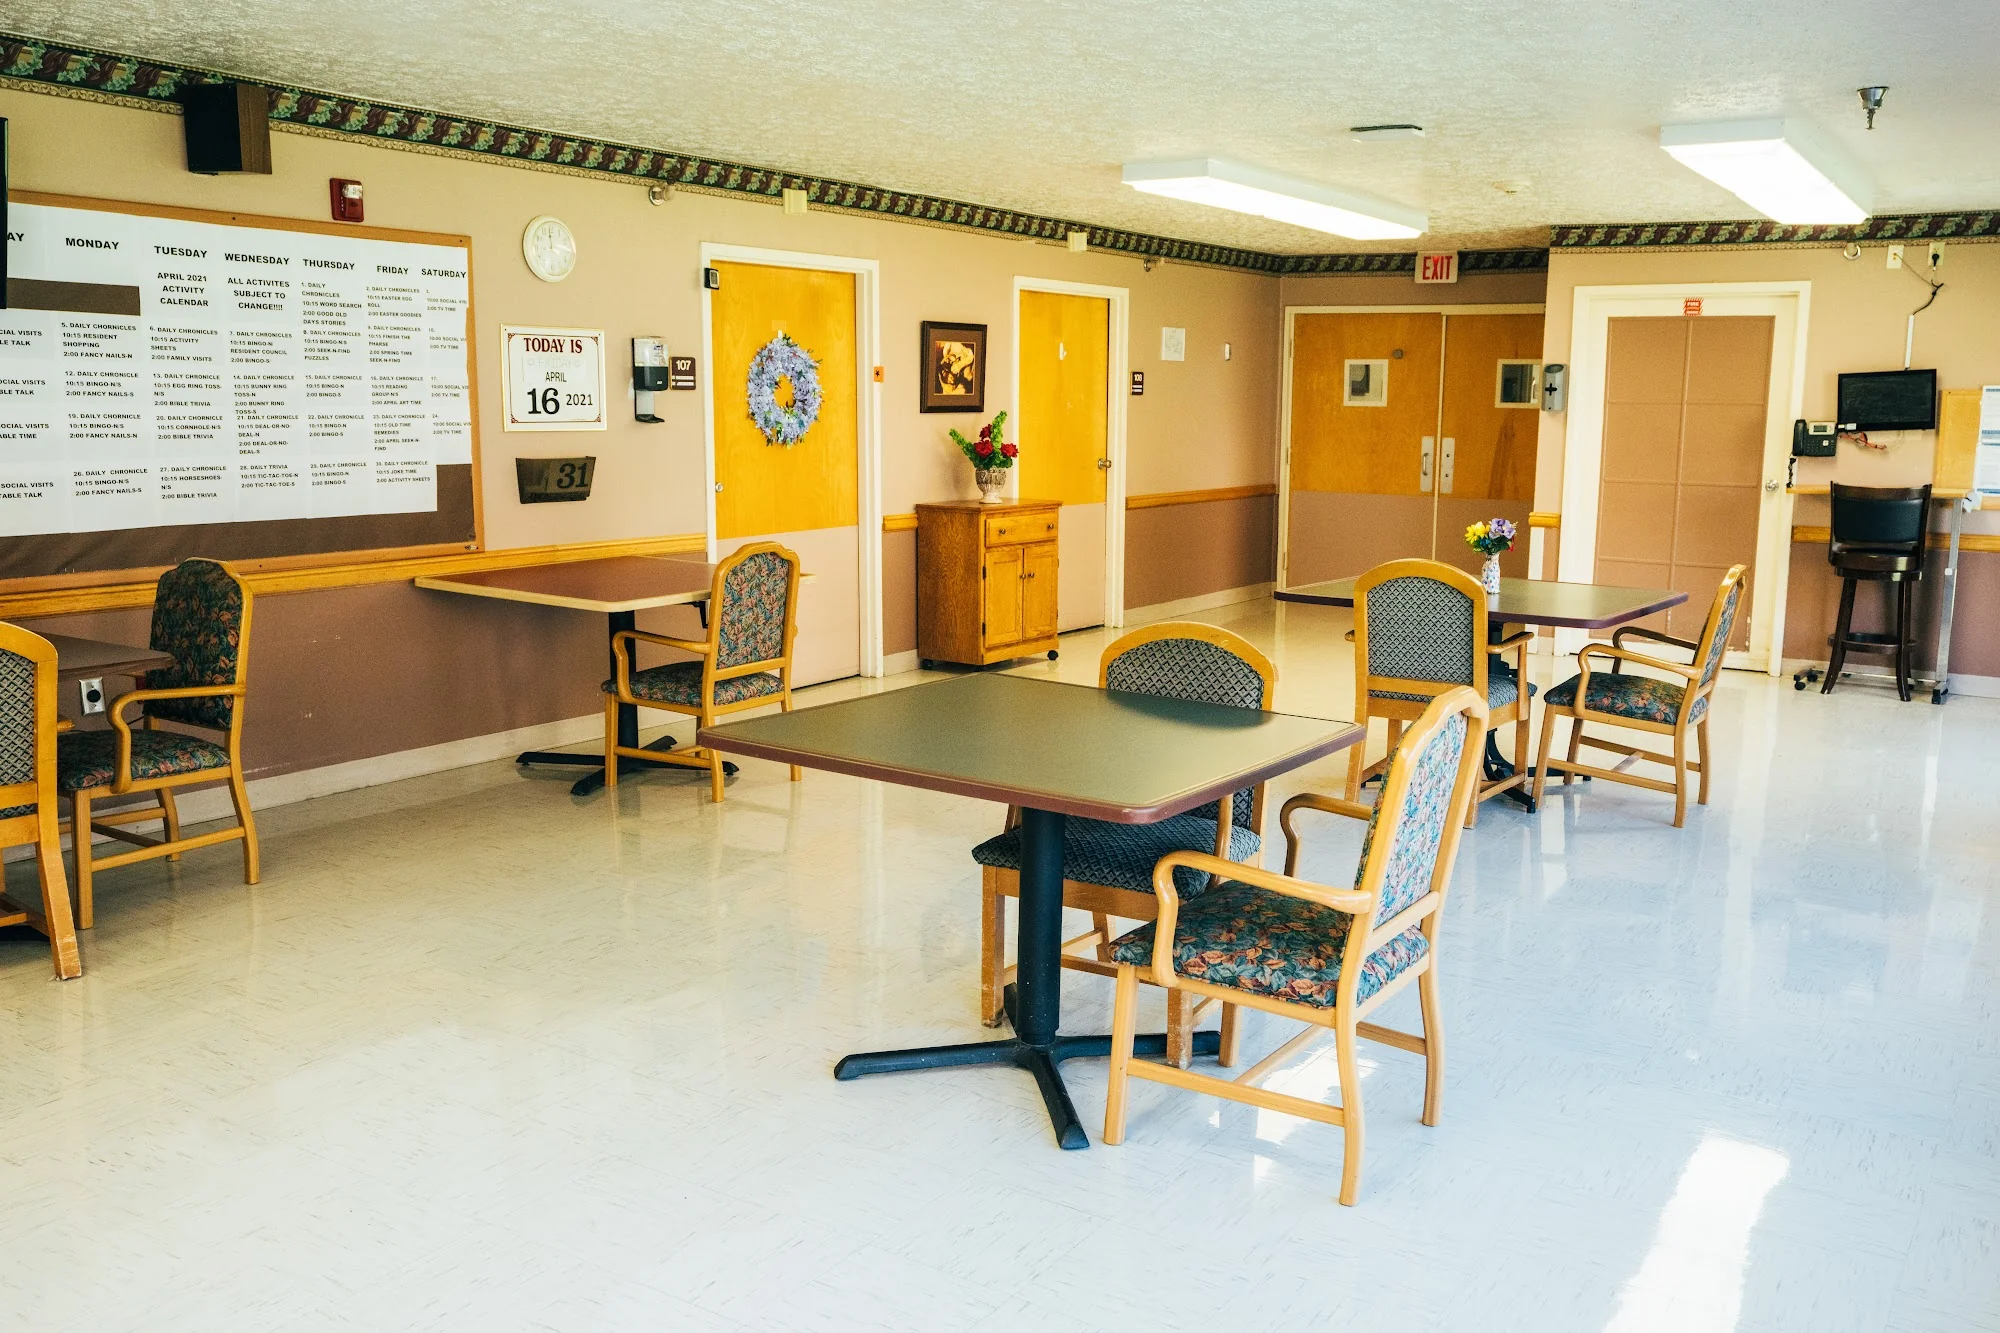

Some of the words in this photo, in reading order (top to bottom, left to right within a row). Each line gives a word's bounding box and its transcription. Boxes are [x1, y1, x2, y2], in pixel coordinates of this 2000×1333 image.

[65, 238, 119, 250] MONDAY
[154, 246, 207, 258] TUESDAY
[224, 253, 289, 265] WEDNESDAY
[303, 259, 355, 270] THURSDAY
[1422, 256, 1452, 280] EXIT
[376, 266, 409, 275] FRIDAY
[421, 268, 466, 278] SATURDAY
[157, 272, 184, 280] APRIL
[246, 279, 290, 287] ACTIVITES
[162, 285, 204, 294] ACTIVITY
[234, 290, 272, 298] SUBJECT
[160, 298, 209, 306] CALENDAR
[238, 302, 283, 311] CHANGE!!!!
[524, 338, 565, 352] TODAY
[570, 340, 582, 354] IS
[676, 360, 692, 370] 107
[546, 372, 567, 382] APRIL
[527, 388, 560, 414] 16
[566, 394, 593, 406] 2021
[557, 463, 588, 488] 31
